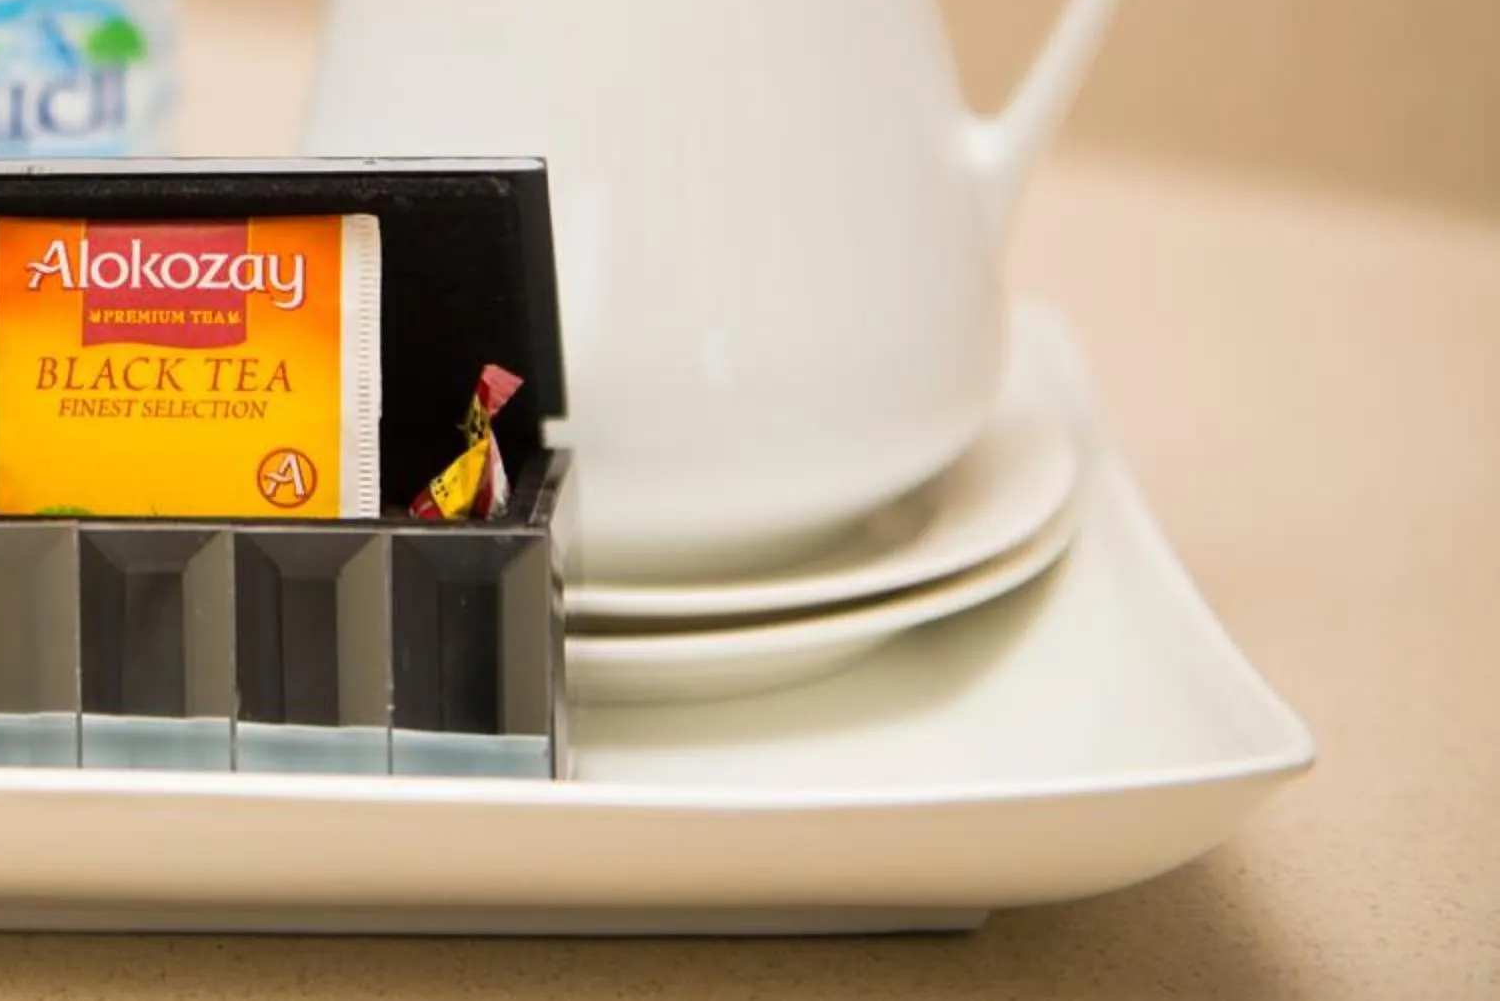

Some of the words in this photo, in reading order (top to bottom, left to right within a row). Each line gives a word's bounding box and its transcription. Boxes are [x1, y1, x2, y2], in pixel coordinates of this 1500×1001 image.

[27, 238, 306, 309] Alokozay
[103, 310, 185, 324] PREMIUM
[190, 310, 224, 325] TEA
[36, 356, 185, 391] BLACK
[205, 357, 293, 393] TEA
[58, 398, 138, 418] FINEST
[141, 399, 268, 419] SELECTION
[264, 453, 306, 497] A
